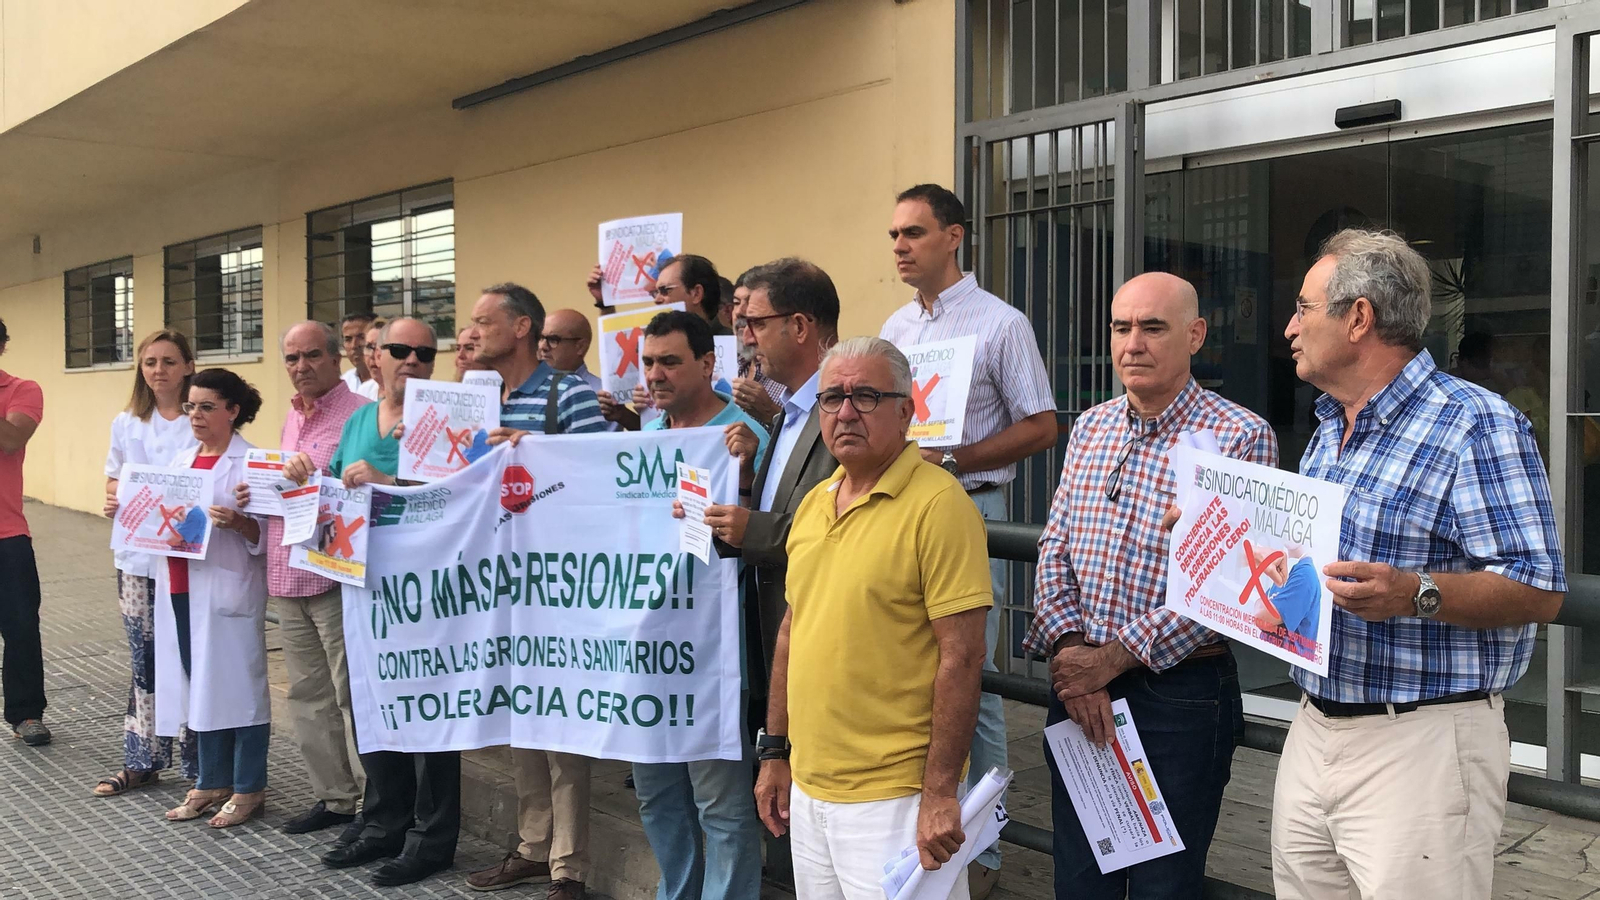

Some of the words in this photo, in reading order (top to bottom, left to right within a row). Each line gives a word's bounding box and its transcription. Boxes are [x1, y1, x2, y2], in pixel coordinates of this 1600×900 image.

[501, 481, 532, 497] STOP
[616, 490, 650, 499] Sindicato
[652, 489, 677, 499] Médico
[1175, 495, 1222, 562] CONCIENCIATE
[1180, 526, 1213, 573] DENUNCIA
[1211, 507, 1229, 529] LAS
[1225, 518, 1252, 550] CERO!
[1254, 504, 1313, 548] MÁLAGA
[1188, 523, 1232, 581] AGRESIONES
[1203, 609, 1213, 620] LAS
[1225, 616, 1244, 633] HORAS
[1244, 624, 1252, 636] EN
[1252, 628, 1259, 639] EL
[378, 647, 449, 680] CONTRA
[449, 641, 478, 673] LAS
[571, 639, 580, 668] A
[582, 638, 695, 675] SANITARIOS
[1092, 755, 1107, 783] DENUNCIA
[1113, 807, 1123, 825] PENAL
[1125, 770, 1137, 790] AVISO
